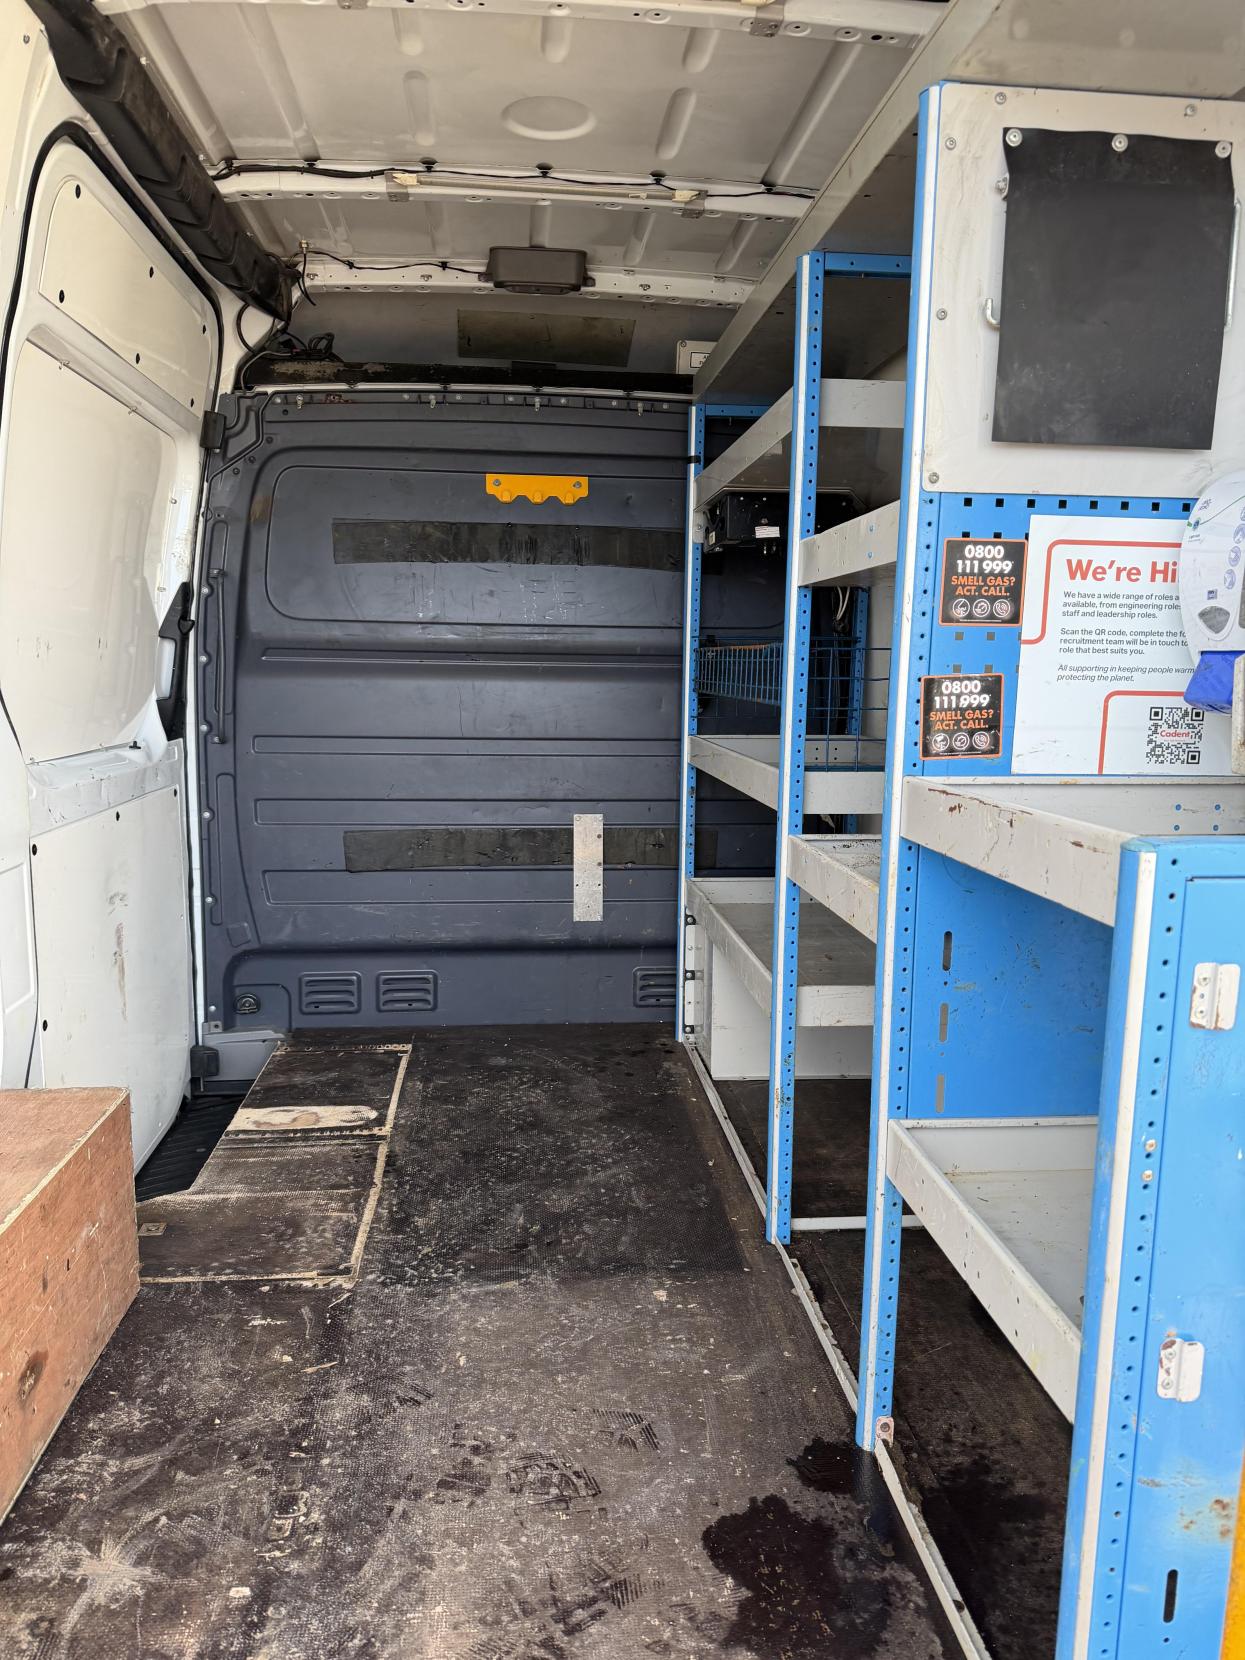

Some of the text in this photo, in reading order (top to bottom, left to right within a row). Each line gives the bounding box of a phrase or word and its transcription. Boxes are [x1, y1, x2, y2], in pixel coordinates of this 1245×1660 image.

[965, 545, 1004, 558] 0800
[957, 560, 1012, 573] 111 999
[1066, 559, 1178, 583] We’re Hi
[951, 576, 1015, 585] SMELL GAS?
[956, 586, 1009, 596] ACT. CALL.
[1064, 591, 1075, 599] We
[1077, 591, 1095, 599] have
[1122, 593, 1144, 601] range
[1145, 592, 1154, 600] of
[1062, 601, 1098, 609] available,
[1099, 601, 1117, 609] from
[1119, 602, 1163, 611] engineering
[1097, 611, 1136, 619] leadership
[1081, 628, 1093, 636] the
[1095, 628, 1106, 636] QR
[1107, 629, 1128, 637] code,
[1129, 630, 1164, 638] complete
[1158, 639, 1180, 647] touch
[1058, 664, 1068, 672] All
[1068, 665, 1108, 673] supporting
[1117, 665, 1147, 674] keeping
[1148, 666, 1173, 675] people
[1057, 674, 1095, 682] protecting
[941, 680, 981, 694] 0800
[934, 694, 990, 709] 111 999
[930, 709, 994, 720] SMELL GAS?
[935, 720, 989, 730] ACT. CALL.
[1160, 730, 1190, 738] Cadent
